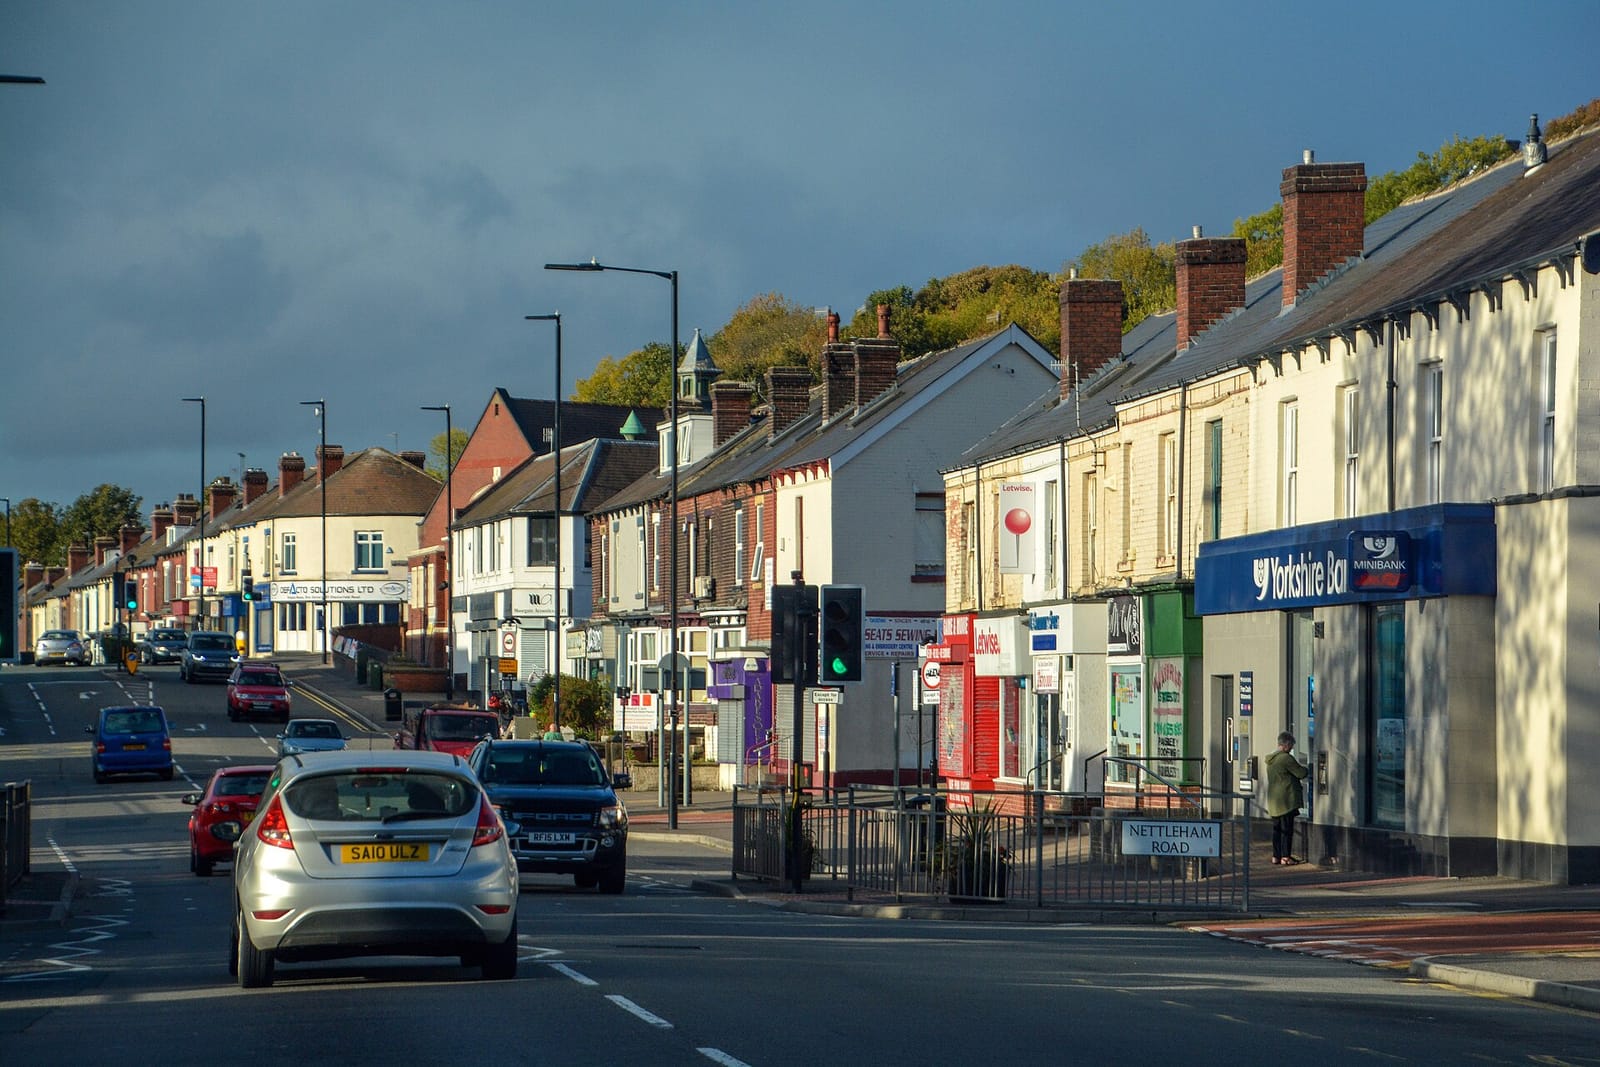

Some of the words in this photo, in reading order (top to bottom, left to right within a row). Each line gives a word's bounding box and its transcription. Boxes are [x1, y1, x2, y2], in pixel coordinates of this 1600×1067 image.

[1003, 484, 1033, 492] Letwise.
[1353, 560, 1406, 570] MINIBANK
[1270, 551, 1325, 600] Yorkshire
[310, 586, 355, 594] SOLUTIONS
[357, 585, 375, 594] LTD
[864, 628, 893, 641] SEATS
[895, 628, 932, 641] SEWING
[975, 626, 1001, 655] Letwise.
[1129, 824, 1212, 839] NETTLEHAM
[351, 846, 385, 860] SA10
[390, 845, 419, 859] ULZ
[1151, 841, 1190, 854] ROAD
